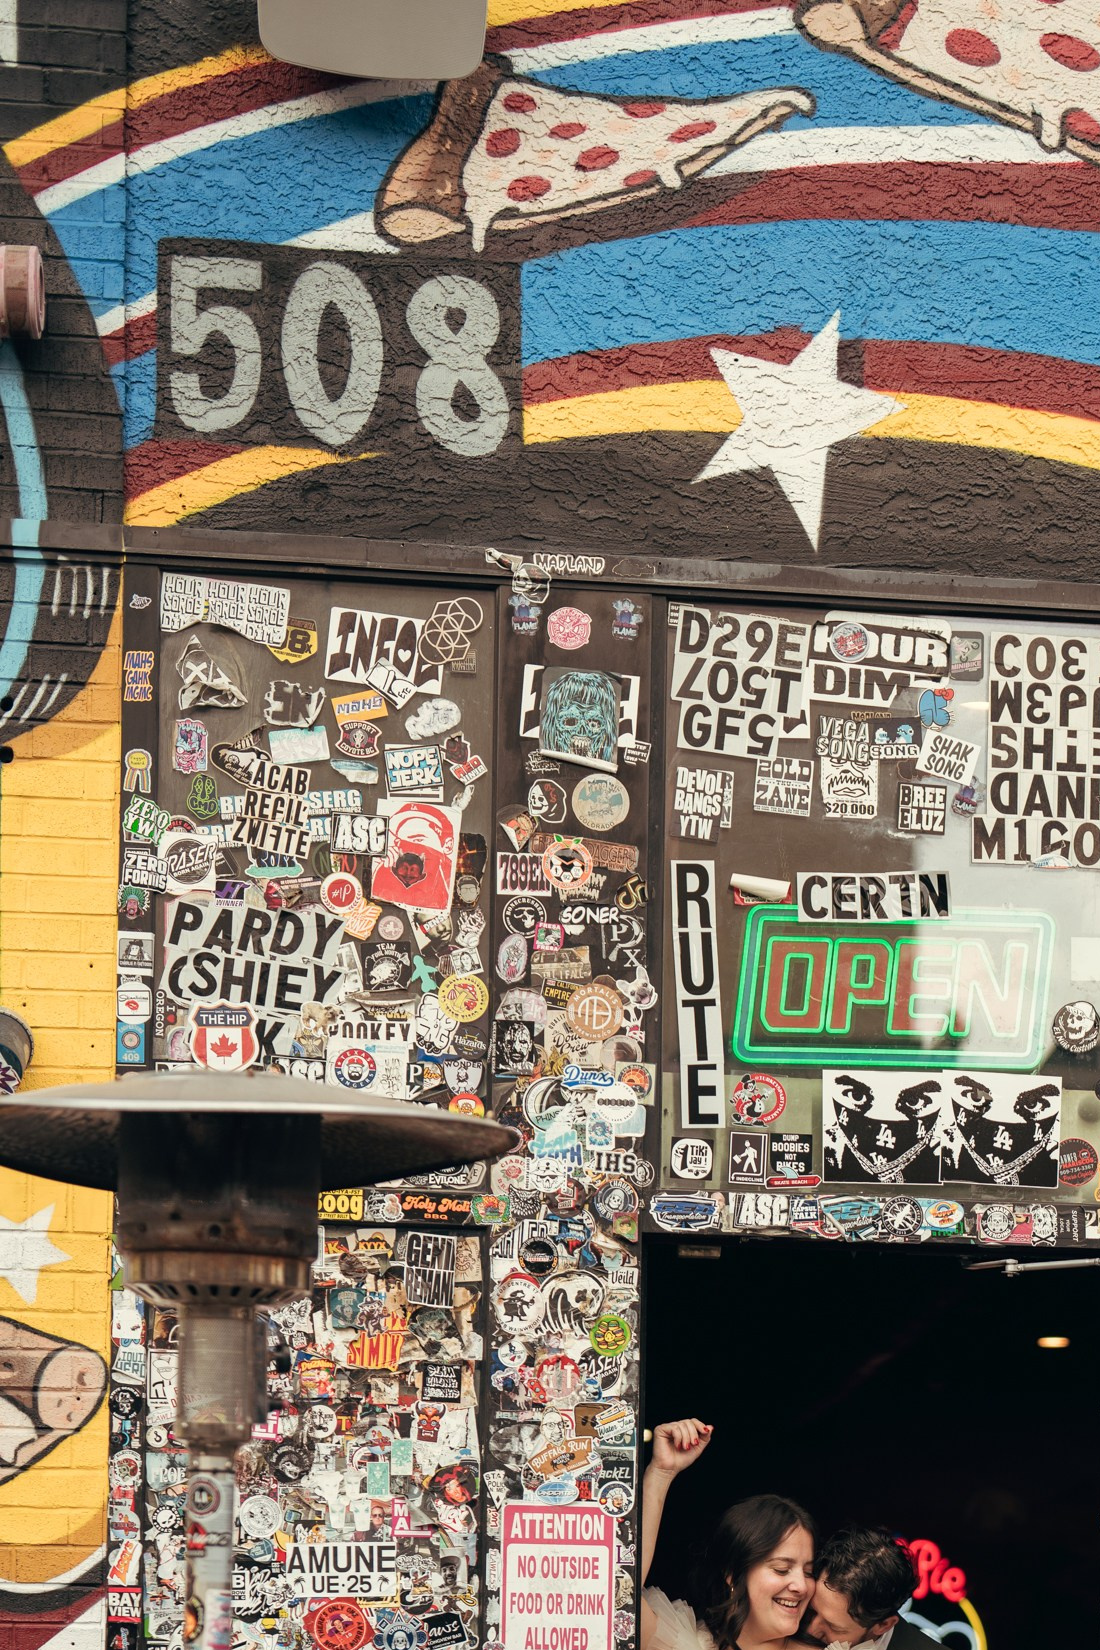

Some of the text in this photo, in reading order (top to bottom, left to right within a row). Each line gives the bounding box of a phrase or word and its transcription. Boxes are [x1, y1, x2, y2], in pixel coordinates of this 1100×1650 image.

[171, 255, 509, 457] 508
[534, 554, 605, 575] MADLAND
[126, 652, 154, 670] MAHS
[951, 660, 982, 669] MINIBIKE
[344, 720, 377, 735] SUPPORT
[820, 716, 869, 742] VEGA
[340, 742, 365, 756] COYOTE
[388, 747, 438, 768] NOPE
[816, 736, 871, 762] SONG
[872, 746, 920, 759] SONG
[930, 735, 975, 763] SHAK
[253, 762, 308, 795] ACAB
[389, 767, 440, 788] JERK
[925, 756, 966, 781] SONG
[676, 767, 724, 795] DEVOL
[310, 790, 361, 808] SERG
[674, 790, 721, 817] BANGS
[901, 784, 946, 808] BREE
[130, 797, 170, 829] ZERO
[579, 815, 615, 830] COLORADO
[900, 807, 945, 832] ELUZ
[336, 815, 385, 852] ASC
[680, 816, 712, 840] YTW
[126, 854, 168, 875] ZERO
[173, 861, 209, 877] BORN AGAIN
[125, 868, 167, 890] FORMS
[801, 874, 950, 920] CERTN
[562, 906, 619, 925] SONER
[169, 901, 344, 960] PARDY
[376, 943, 396, 951] TEAM
[544, 987, 572, 1000] EMPIRE
[573, 986, 619, 1005] MORTALIS
[676, 863, 719, 1125] RUTE
[760, 936, 1025, 1038] OPEN
[156, 991, 165, 1038] OREGON
[200, 1014, 247, 1026] THE HIP
[454, 1033, 487, 1049] Hazards
[122, 1053, 140, 1063] 409
[444, 1060, 482, 1070] WONDER
[782, 1134, 799, 1142] DUMP
[876, 1123, 896, 1149] LA
[994, 1125, 1013, 1151] LA
[690, 1144, 709, 1157] Tiki
[772, 1141, 810, 1153] BOOBIES
[784, 1153, 797, 1161] NOT
[595, 1152, 636, 1175] IHS
[776, 1161, 805, 1173] BIKES
[870, 1152, 888, 1167] LA
[986, 1153, 1004, 1168] LA
[402, 1195, 436, 1212] Holy
[741, 1195, 789, 1227] ASC
[986, 1205, 1010, 1216] ALWAYS
[424, 1213, 448, 1221] BBQ
[662, 1212, 707, 1221] Transportation
[793, 1211, 817, 1220] TALK
[983, 1227, 1011, 1239] FIENDING
[508, 1315, 542, 1332] WAINWRIGHT
[598, 1424, 618, 1435] Water
[532, 1440, 589, 1469] BUFFALO RUN
[511, 1512, 605, 1541] ATTENTION
[288, 1545, 396, 1573] AMUNE
[517, 1555, 600, 1580] NO OUTSIDE
[108, 1593, 141, 1608] BAY
[510, 1592, 605, 1615] FOOD OR DRINK
[110, 1604, 142, 1618] VIEW
[525, 1626, 589, 1650] ALLOWED
